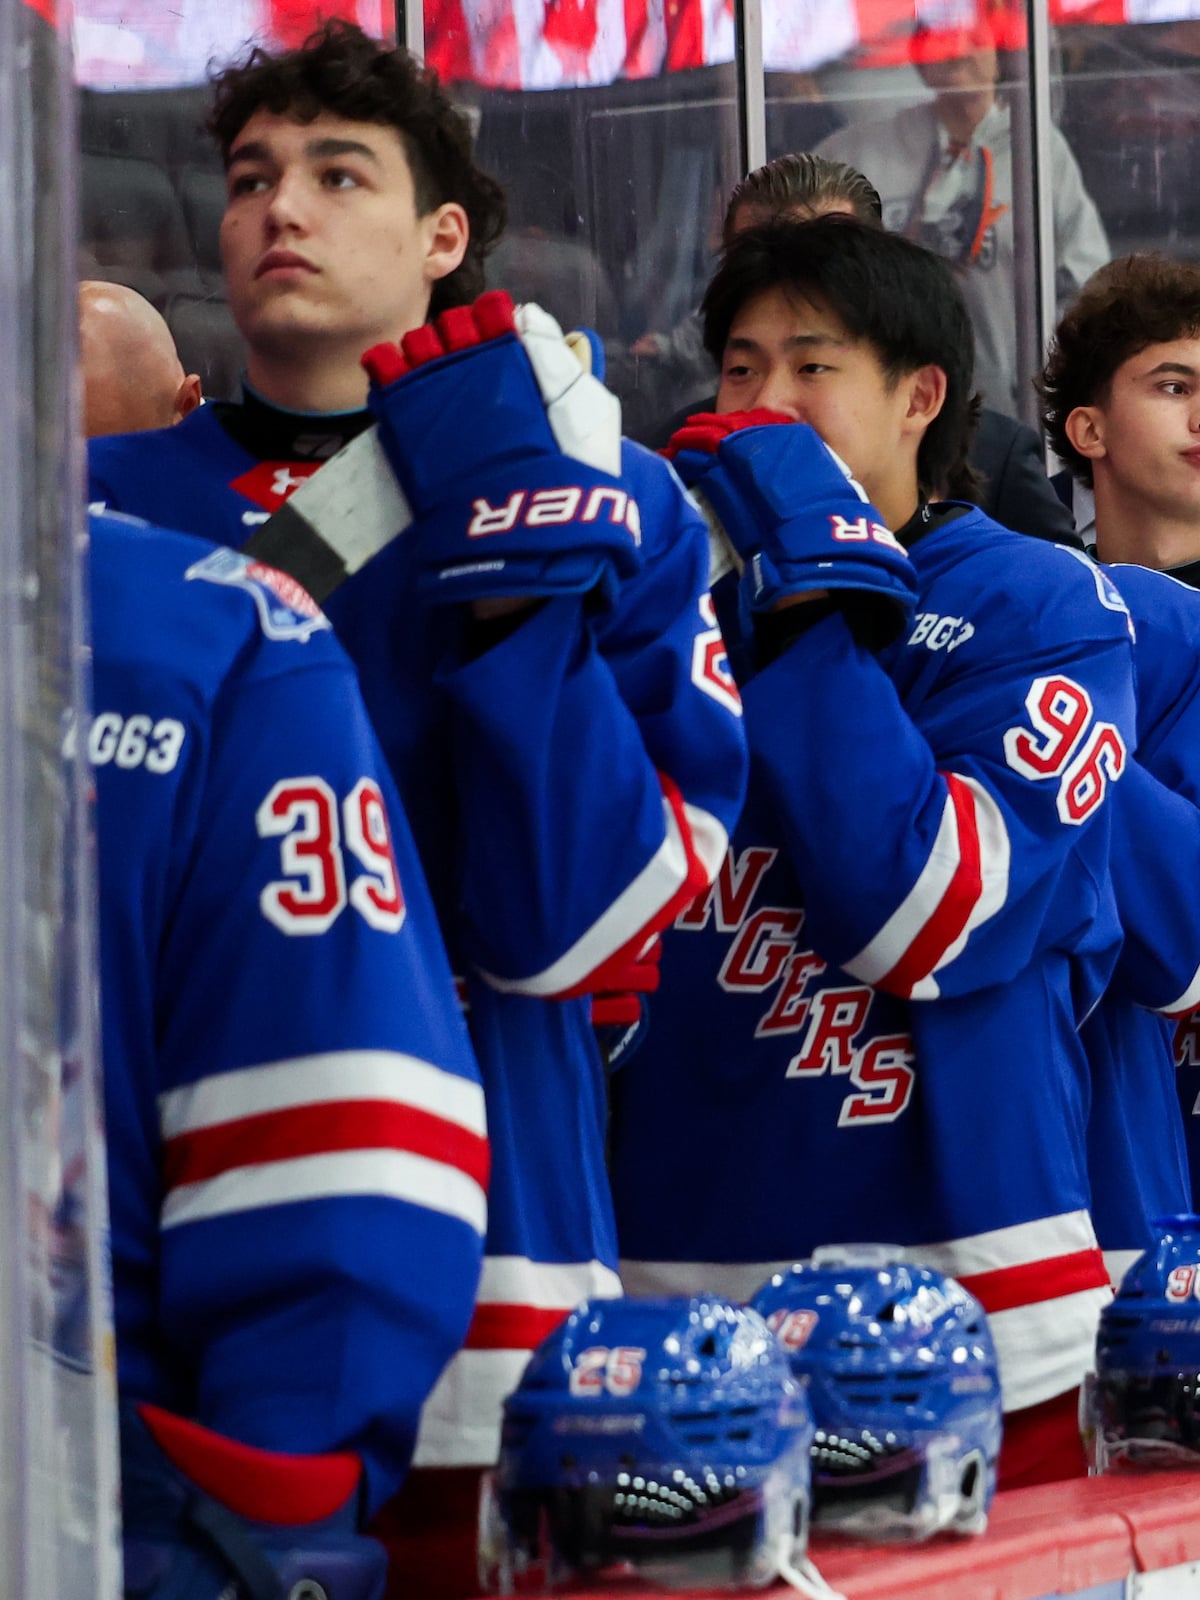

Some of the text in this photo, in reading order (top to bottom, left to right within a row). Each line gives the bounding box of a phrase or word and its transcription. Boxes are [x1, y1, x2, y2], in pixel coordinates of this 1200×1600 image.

[1003, 674, 1127, 825] 96
[255, 775, 407, 937] 39
[570, 1346, 647, 1398] 25
